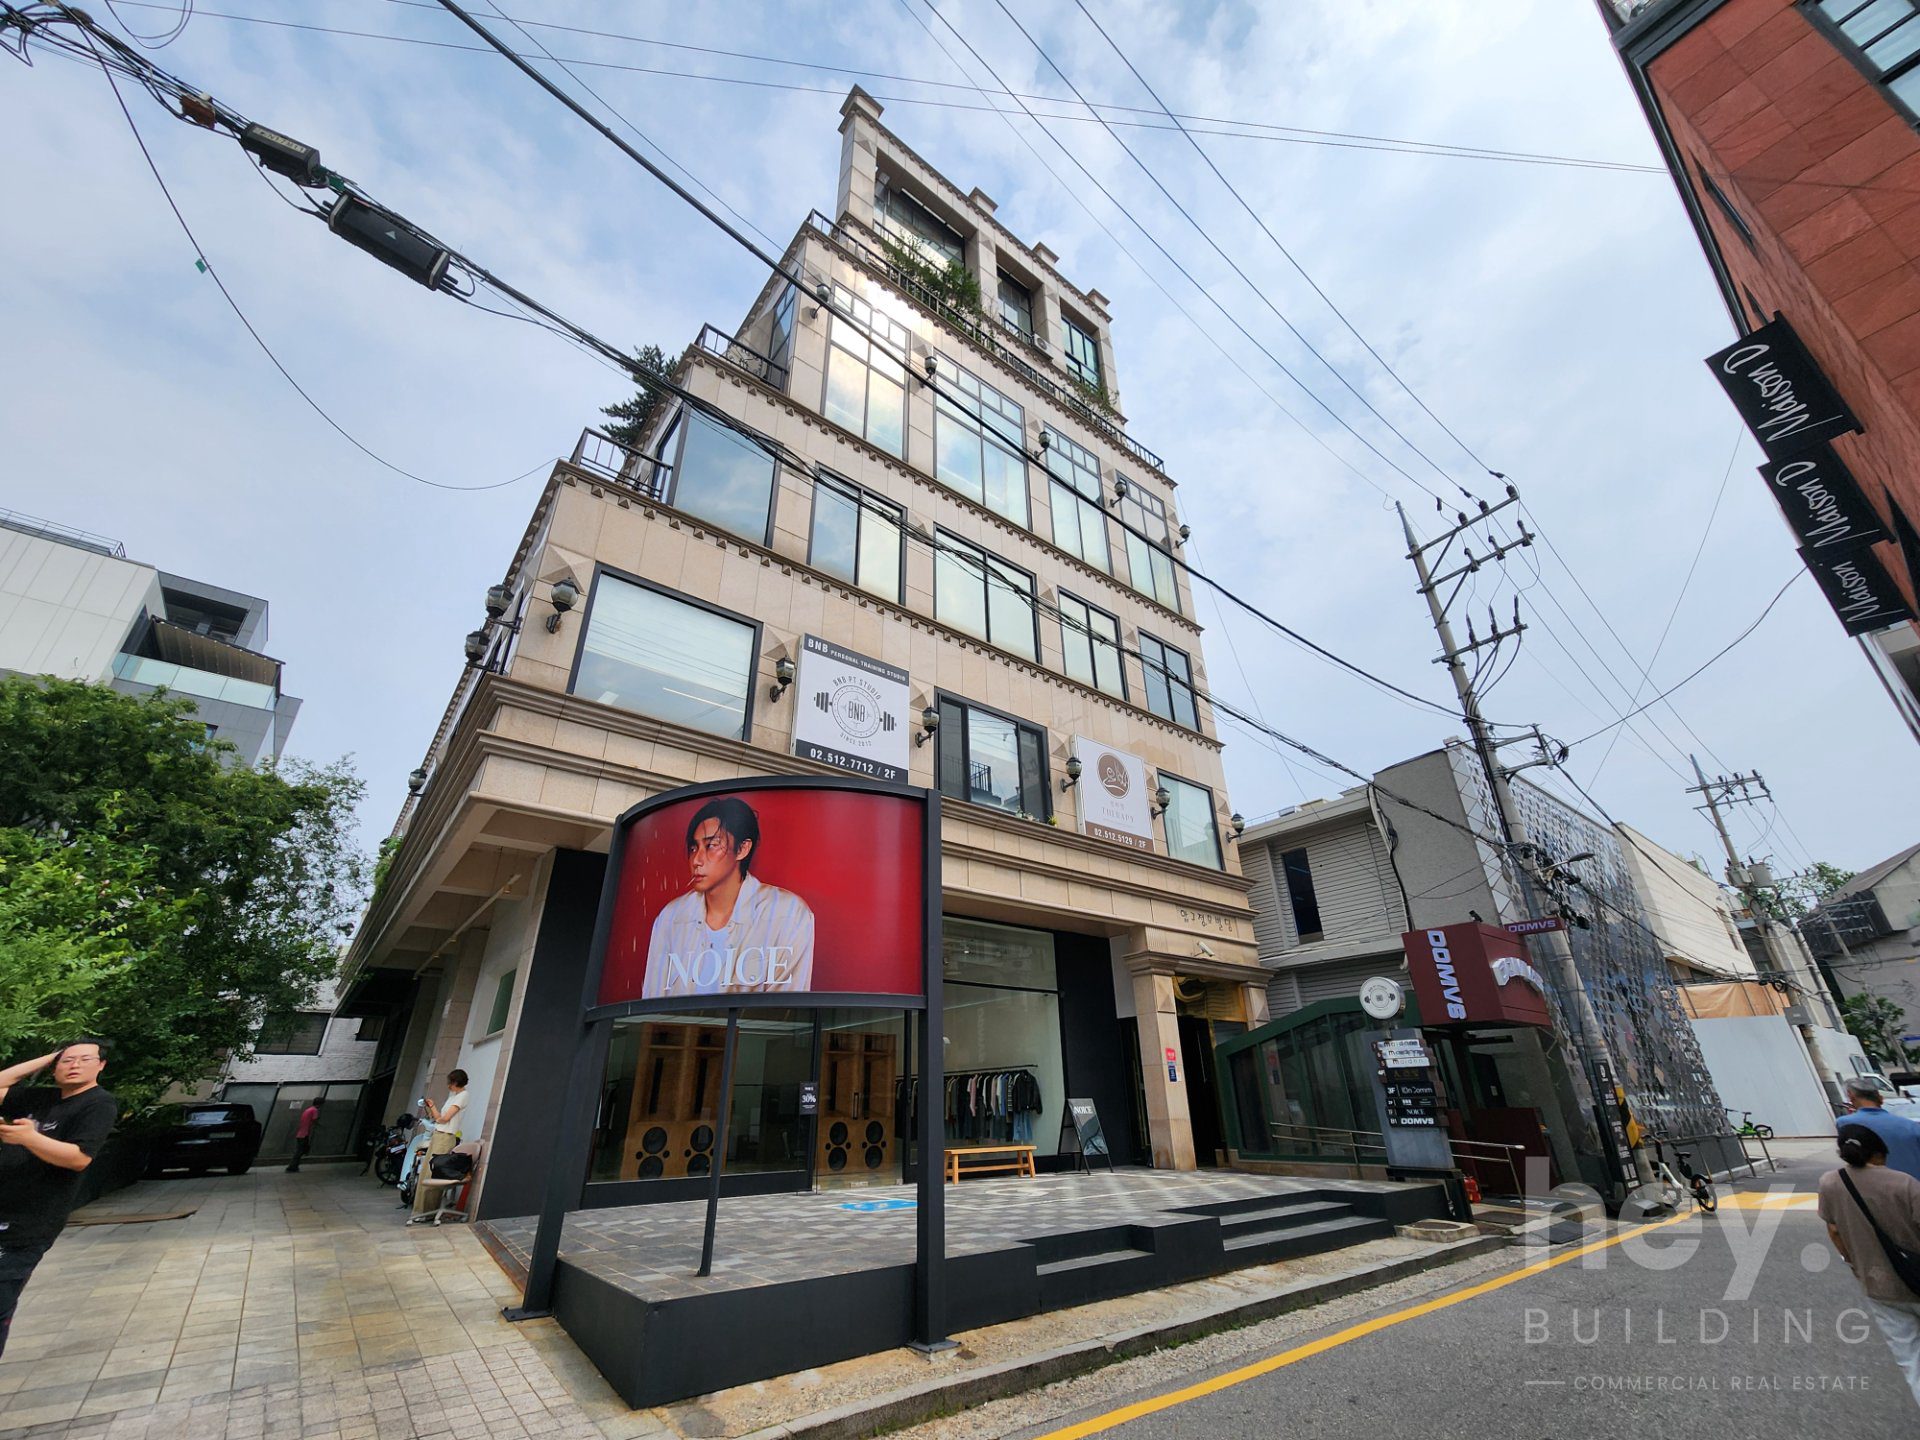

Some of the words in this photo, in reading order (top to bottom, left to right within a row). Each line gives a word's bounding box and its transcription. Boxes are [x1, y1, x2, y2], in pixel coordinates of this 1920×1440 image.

[1747, 361, 1844, 442] Maison
[1797, 477, 1881, 548] Maison
[1831, 561, 1905, 623] Maison
[808, 638, 829, 653] BNB
[830, 650, 860, 664] PERSONAL
[861, 660, 886, 674] TRAINING
[886, 670, 906, 681] STUDIO
[860, 679, 882, 700] STUDIO
[848, 701, 866, 723] BNB
[810, 748, 874, 774] 02.512.7712
[884, 768, 896, 779] 2F
[1094, 827, 1133, 845] 02.512.5129
[1138, 839, 1146, 849] 2F
[664, 946, 794, 991] NOICE
[1401, 1117, 1435, 1125] DOMVS
